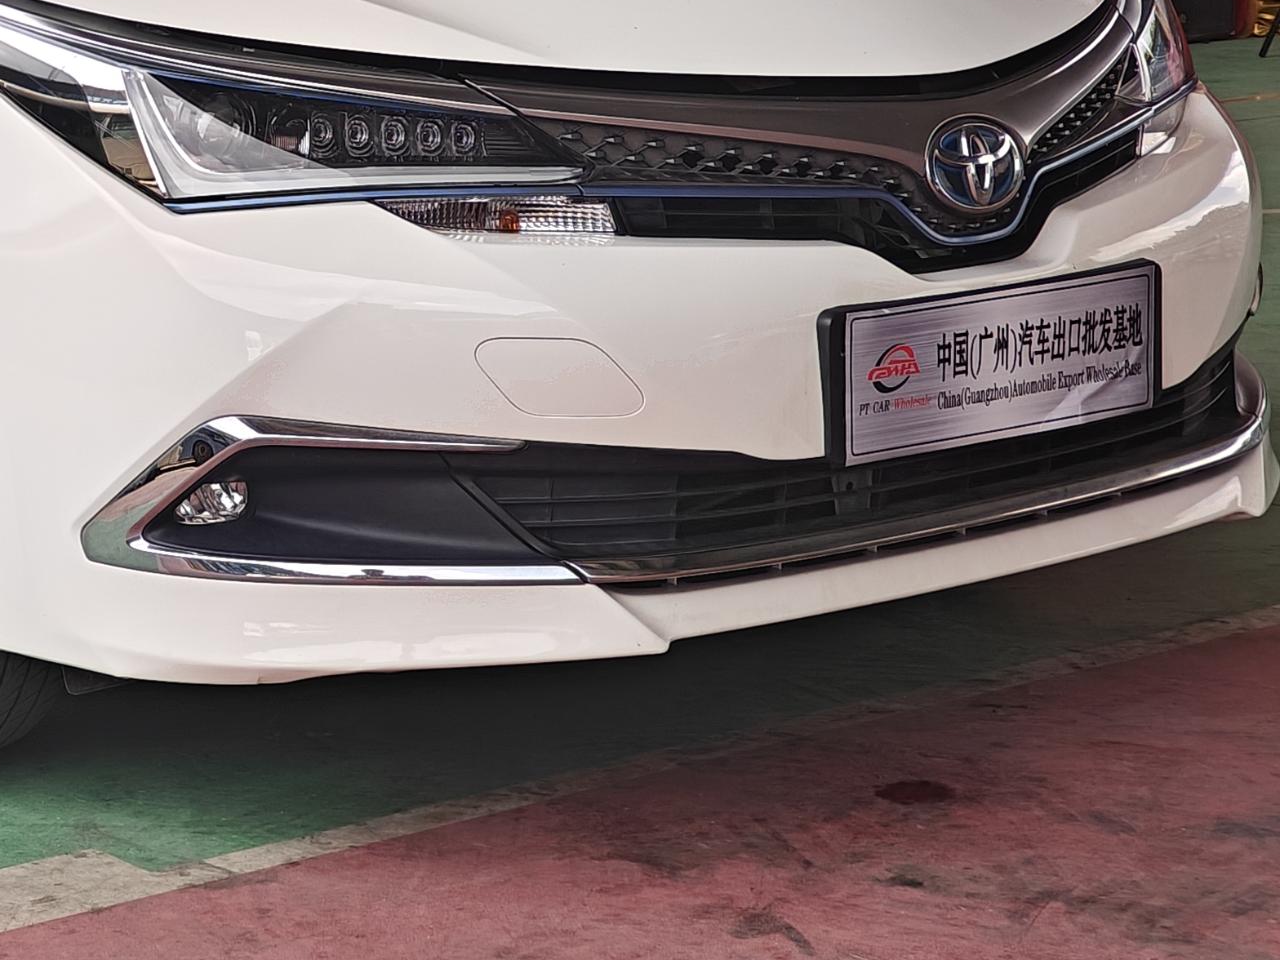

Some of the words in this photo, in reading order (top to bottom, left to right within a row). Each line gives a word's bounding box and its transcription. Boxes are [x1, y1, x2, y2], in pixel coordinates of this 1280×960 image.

[1057, 369, 1085, 392] Export
[859, 402, 871, 416] PT
[873, 399, 891, 414] CAR
